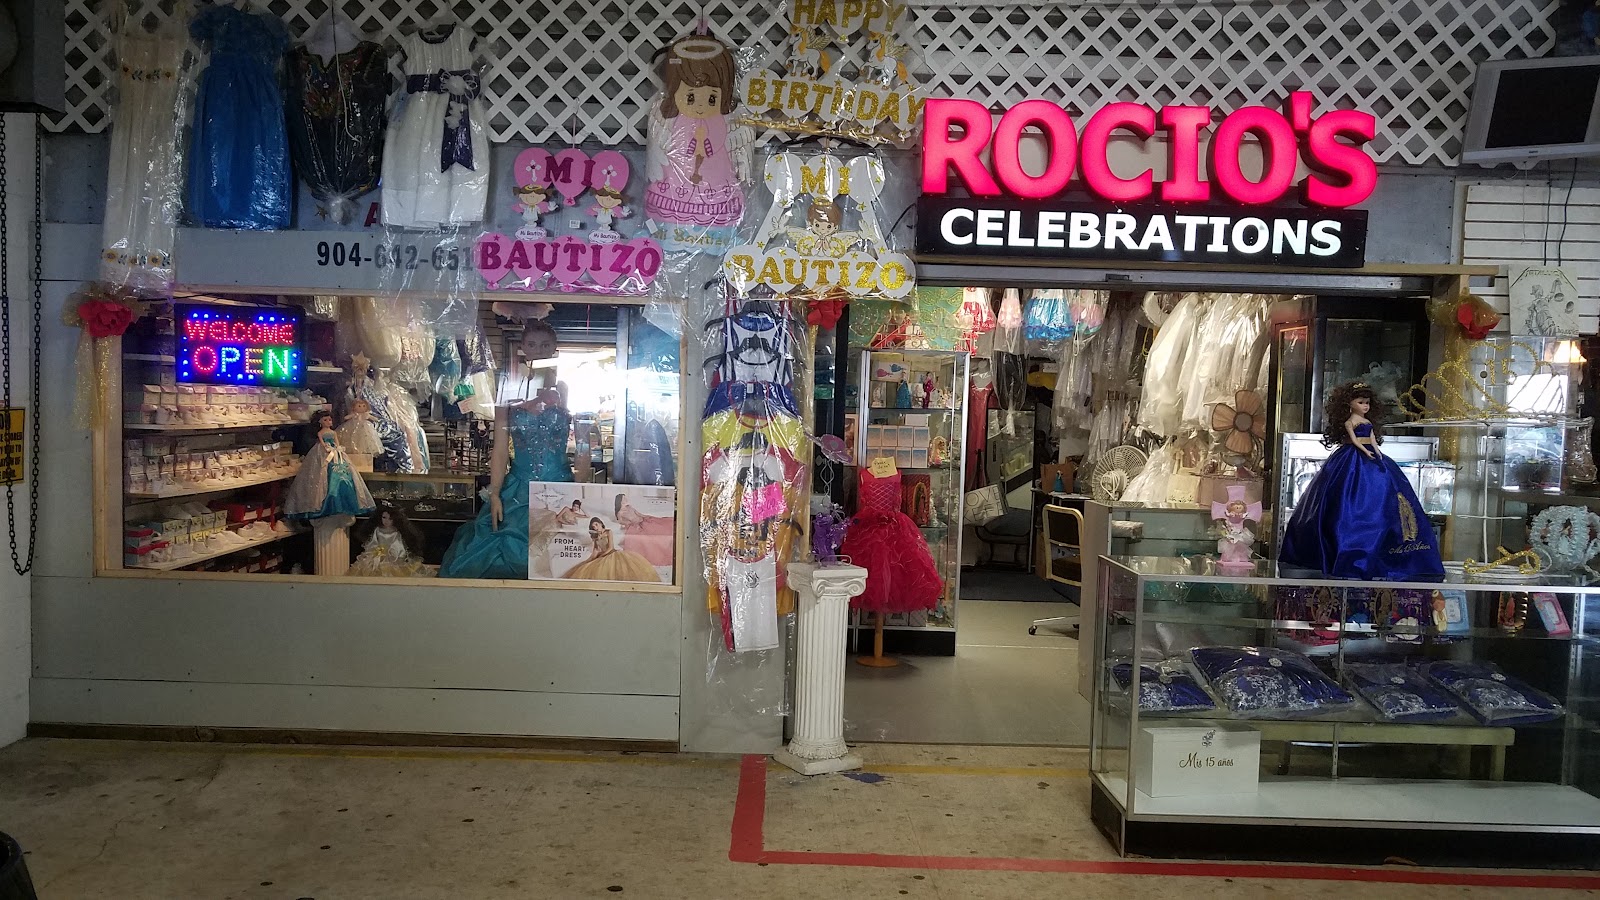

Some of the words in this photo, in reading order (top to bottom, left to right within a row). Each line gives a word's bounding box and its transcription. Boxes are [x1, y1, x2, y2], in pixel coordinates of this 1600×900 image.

[793, 0, 906, 32] HAPPY
[746, 78, 927, 125] BIRTHDAY
[921, 91, 1378, 208] ROCIO'S
[543, 155, 597, 187] MI
[800, 165, 851, 195] MI
[939, 208, 1343, 257] CELEBRATIONS
[316, 241, 473, 271] 904-642-651
[478, 240, 661, 278] BAUTIZO
[731, 254, 907, 291] BAUTIZO
[185, 319, 294, 344] WELCOME
[193, 345, 290, 376] OPEN
[966, 486, 1000, 507] OVE
[1179, 752, 1202, 768] Mis
[1206, 756, 1215, 767] 15
[1217, 757, 1234, 767] años
